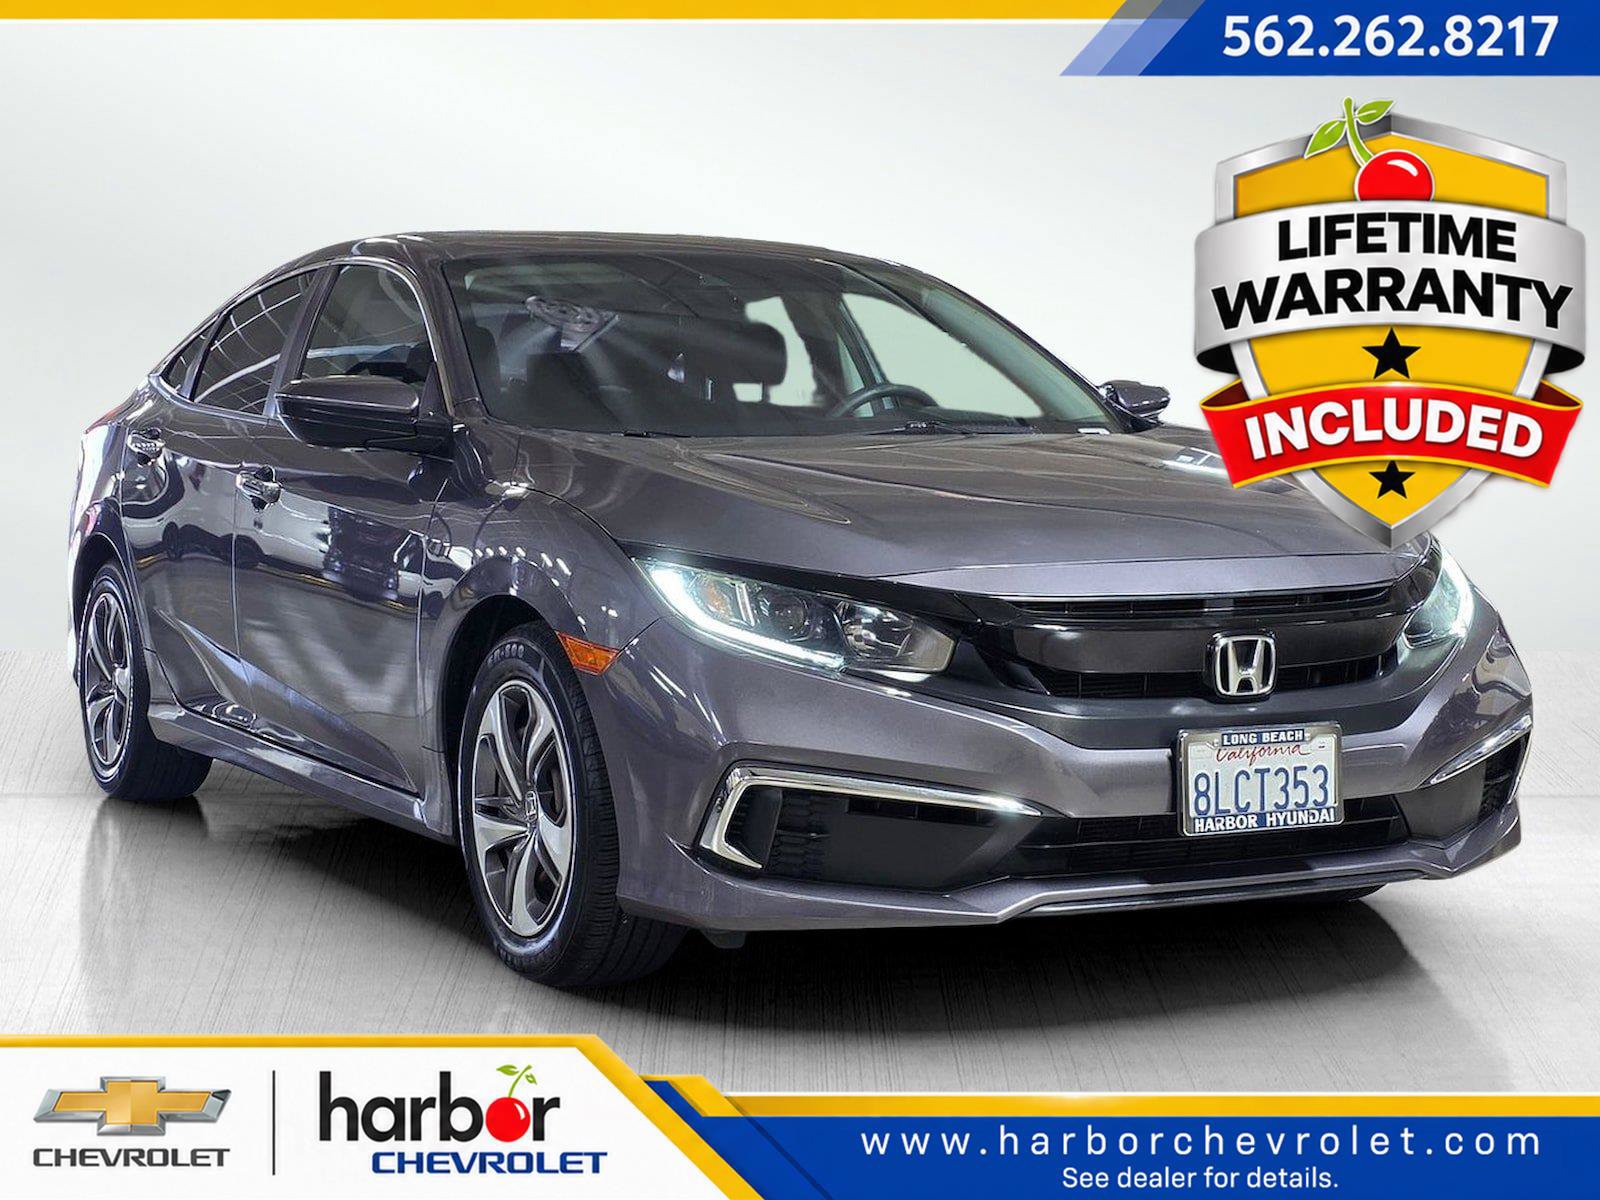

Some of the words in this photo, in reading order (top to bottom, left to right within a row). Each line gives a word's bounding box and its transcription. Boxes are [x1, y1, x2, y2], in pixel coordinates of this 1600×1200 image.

[1222, 732, 1258, 746] LONG
[1261, 730, 1303, 743] BEACH
[1216, 743, 1311, 766] California
[1194, 764, 1329, 816] 8LCT353
[1194, 814, 1258, 833] HARBOR
[1265, 807, 1335, 827] HYUNDAI
